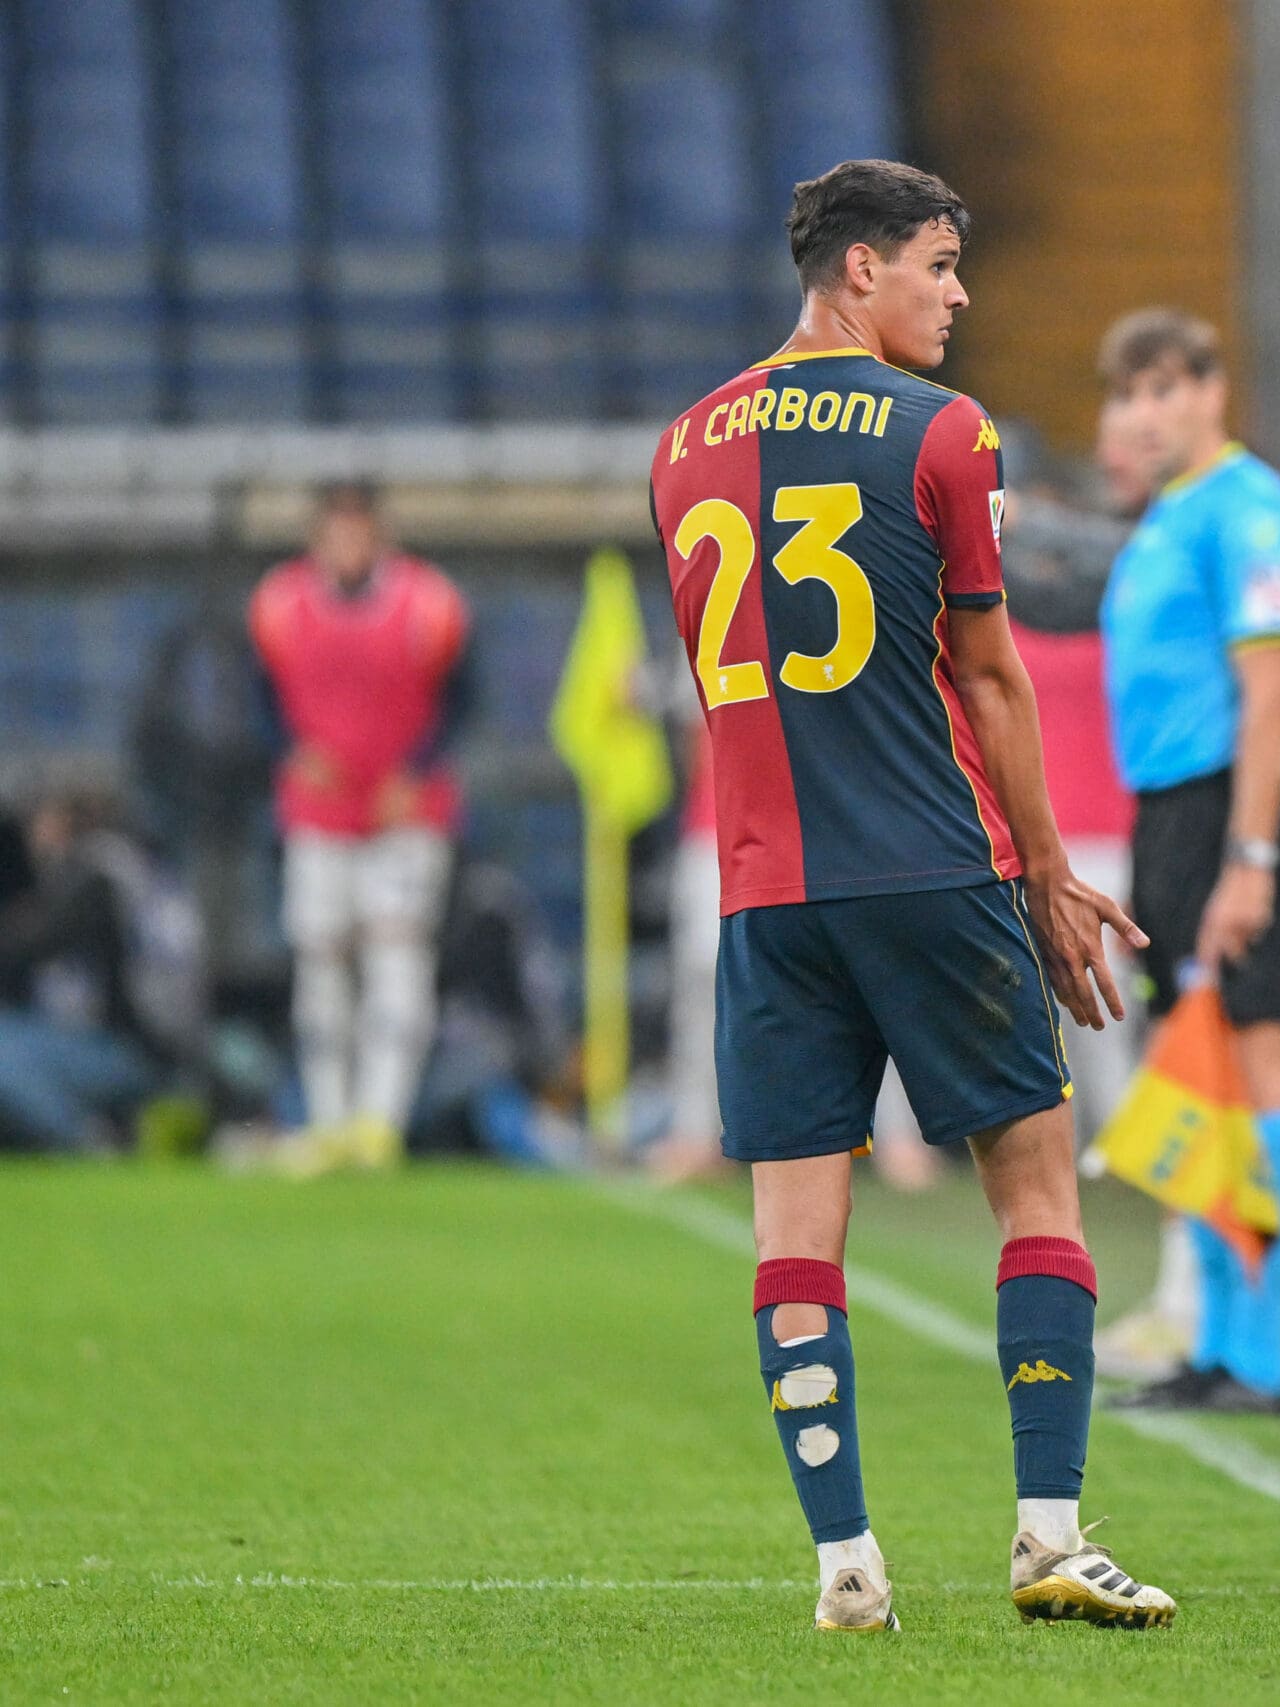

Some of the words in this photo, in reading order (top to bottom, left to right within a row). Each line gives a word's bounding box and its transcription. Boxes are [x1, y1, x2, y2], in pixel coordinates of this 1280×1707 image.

[669, 418, 690, 465] V.
[704, 387, 894, 447] CARBONI
[674, 482, 876, 711] 23
